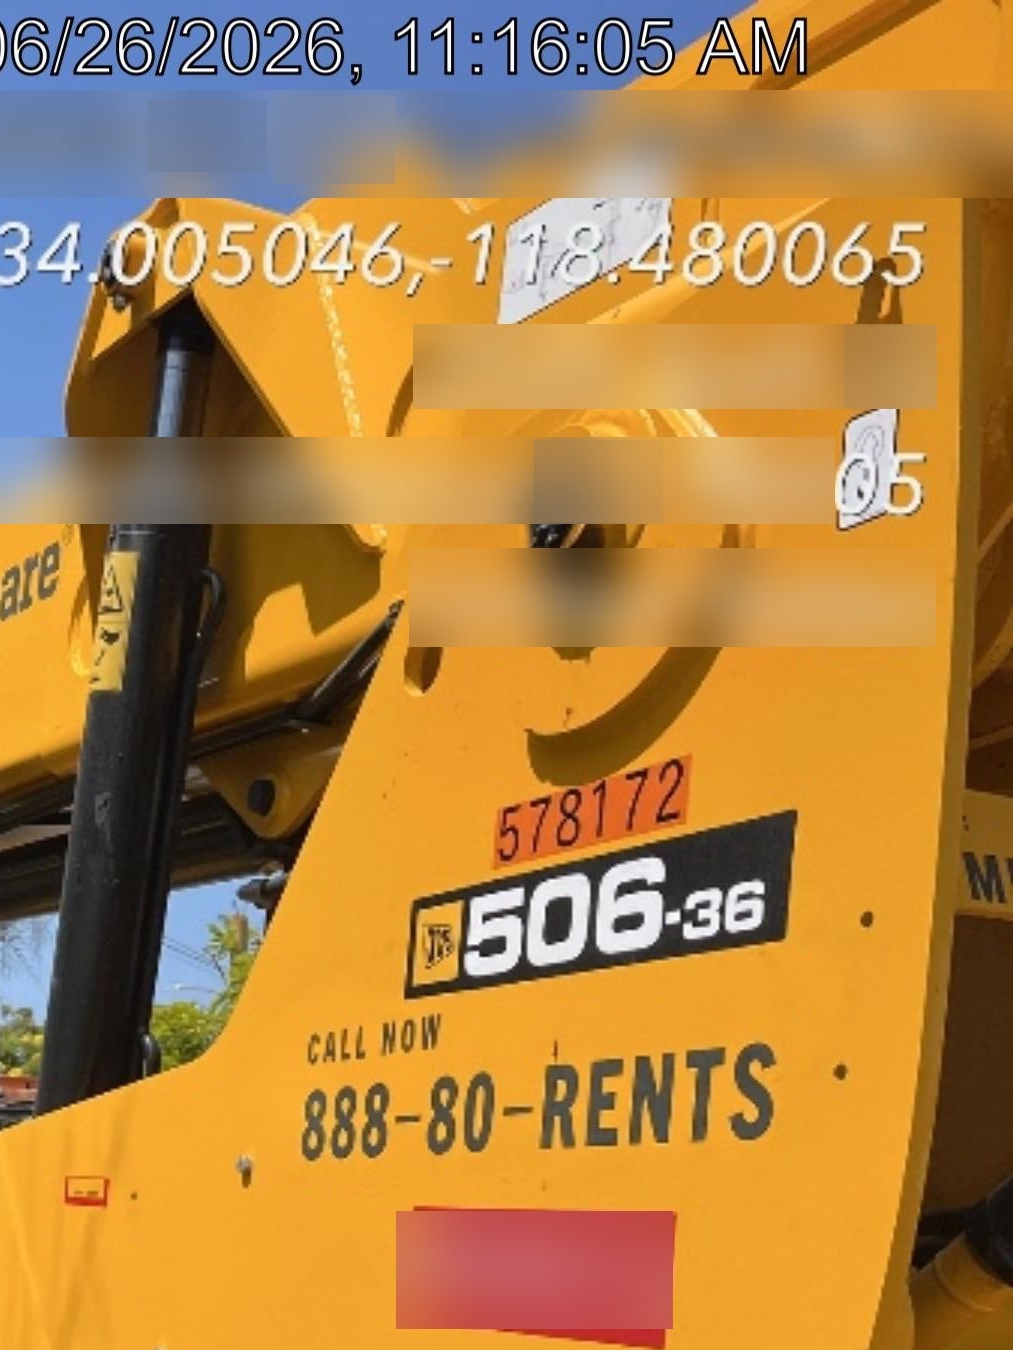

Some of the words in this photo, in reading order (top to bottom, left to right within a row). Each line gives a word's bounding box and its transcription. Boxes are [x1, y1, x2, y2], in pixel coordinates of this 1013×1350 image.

[496, 757, 685, 862] 578172
[463, 855, 766, 978] 506-36
[961, 851, 1013, 904] M
[307, 1026, 367, 1066] CALL
[380, 1013, 443, 1057] NOW
[301, 1041, 777, 1162] 888-80-RENTS
